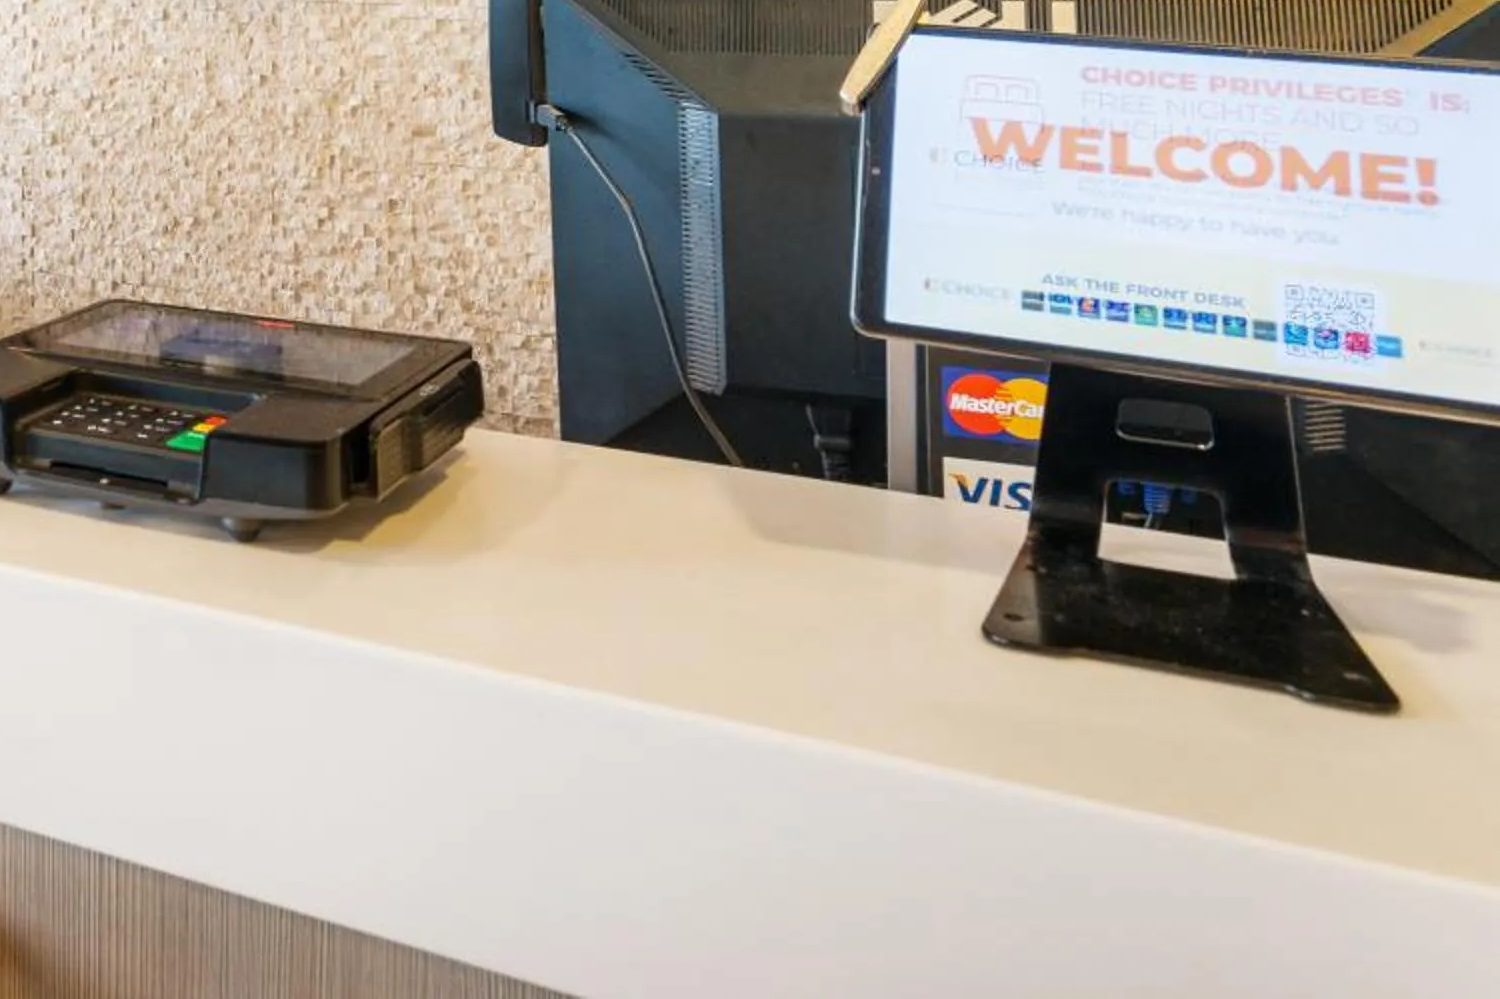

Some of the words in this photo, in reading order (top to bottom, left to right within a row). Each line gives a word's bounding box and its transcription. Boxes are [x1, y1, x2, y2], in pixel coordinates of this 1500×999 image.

[1080, 65, 1198, 93] CHOICE
[1208, 75, 1404, 108] PRIVILEGES
[1080, 90, 1158, 115] FREE
[1164, 97, 1283, 126] NIGHTS
[1290, 109, 1363, 134] AND
[1374, 114, 1420, 138] SO
[968, 116, 1441, 207] WELCOME!
[1122, 207, 1190, 233] happy
[1198, 214, 1225, 233] to
[1230, 218, 1287, 240] have
[1041, 273, 1081, 290] ASK
[1086, 277, 1121, 295] THE
[1126, 282, 1189, 304] FRONT
[1194, 291, 1247, 309] DESK
[950, 393, 1045, 418] MasterCar
[950, 473, 1032, 510] VIS
